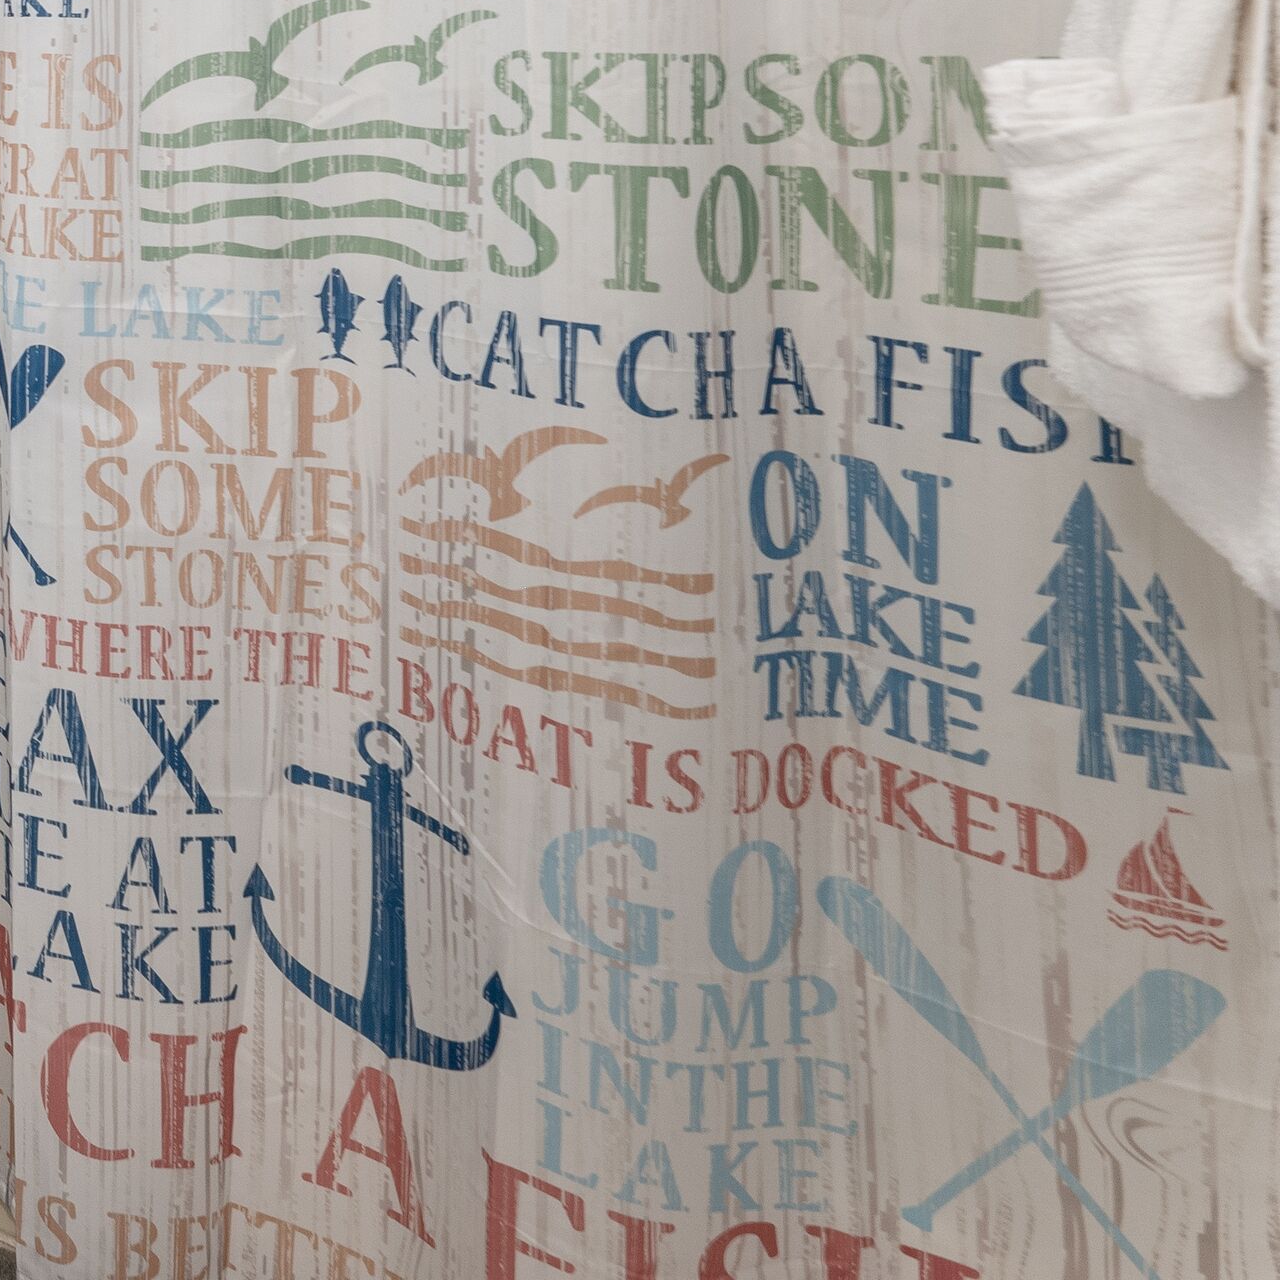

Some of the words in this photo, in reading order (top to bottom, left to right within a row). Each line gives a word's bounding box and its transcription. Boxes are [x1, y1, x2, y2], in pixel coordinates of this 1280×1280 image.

[40, 53, 124, 132] IS
[489, 49, 727, 146] SKIP
[44, 147, 129, 201] AT
[487, 157, 1041, 319] STONE
[78, 280, 286, 346] LAKE
[429, 300, 738, 420] CATCH
[759, 326, 824, 417] A
[80, 357, 362, 459] SKIP
[82, 456, 364, 546] SOME
[748, 449, 953, 586] ON
[82, 543, 384, 624] STONES
[752, 568, 983, 678] LAKE
[232, 625, 373, 700] THE
[397, 656, 593, 791] BOAT
[624, 739, 706, 816] IS
[731, 741, 1090, 881] DOCKED
[752, 648, 992, 767] TIME
[105, 836, 238, 915] AT
[539, 827, 800, 973] GO
[531, 946, 838, 1052] JUMP
[535, 1020, 648, 1126] IN
[664, 1055, 857, 1137] THE
[301, 1066, 437, 1250] A
[535, 1097, 829, 1214] LAKE
